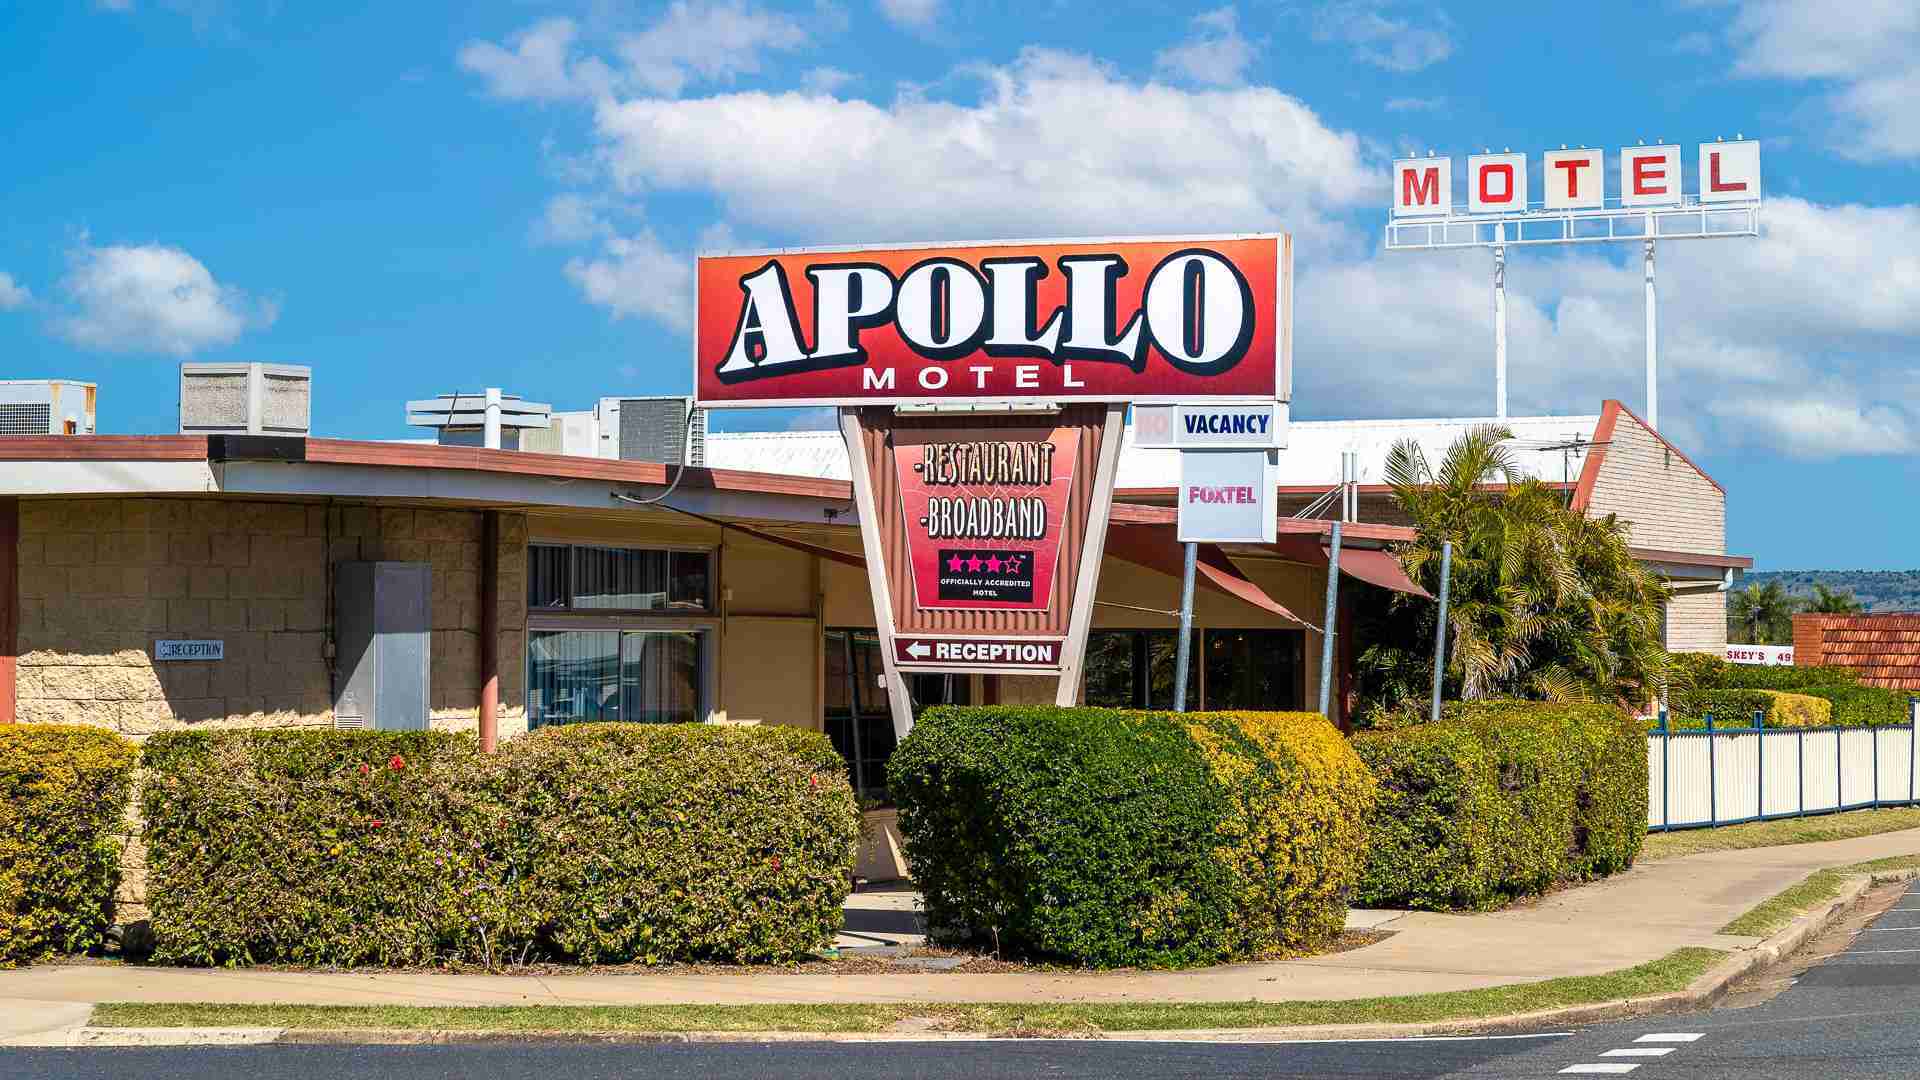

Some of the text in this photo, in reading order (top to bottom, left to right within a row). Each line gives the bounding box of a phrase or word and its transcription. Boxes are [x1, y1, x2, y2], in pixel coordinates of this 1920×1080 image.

[1402, 152, 1747, 206] MOTEL
[716, 248, 1256, 376] APOLLO
[863, 363, 1085, 390] MOTEL
[1184, 414, 1270, 434] VACANCY
[922, 441, 1056, 486] RESTAURANT
[1189, 486, 1257, 504] FOXTEL
[927, 497, 1047, 540] BROADBAND
[940, 578, 1031, 587] OFFICIALLY ACCREDITED
[170, 642, 222, 657] RECEPTION
[935, 642, 1053, 662] RECEPTION
